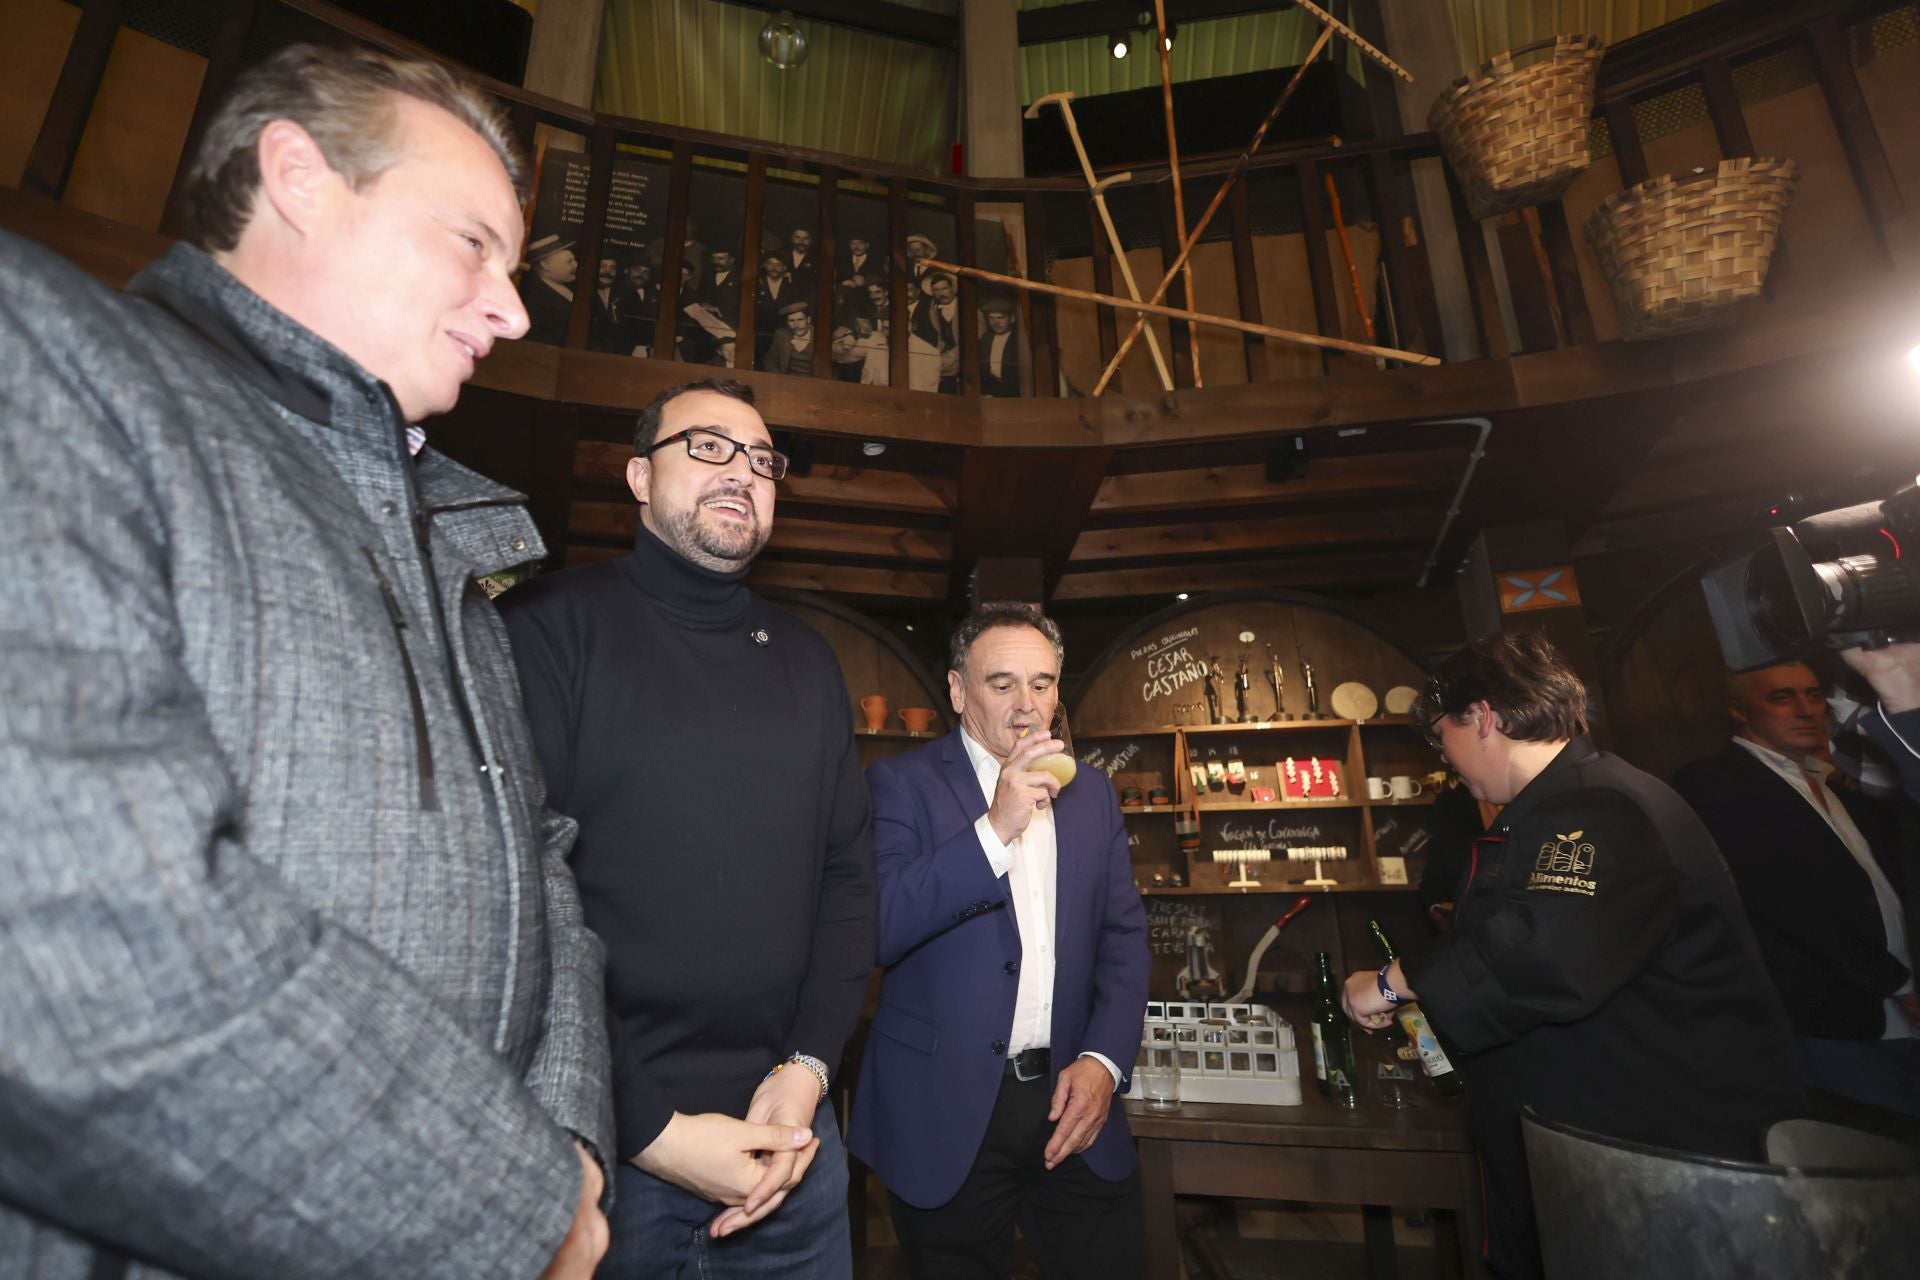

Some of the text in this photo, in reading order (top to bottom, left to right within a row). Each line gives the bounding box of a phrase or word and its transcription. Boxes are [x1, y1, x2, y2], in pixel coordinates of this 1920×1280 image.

[1130, 643, 1158, 661] PIEZAS
[1143, 660, 1208, 702] CASTAÑO
[1527, 871, 1597, 890] Alimentos
